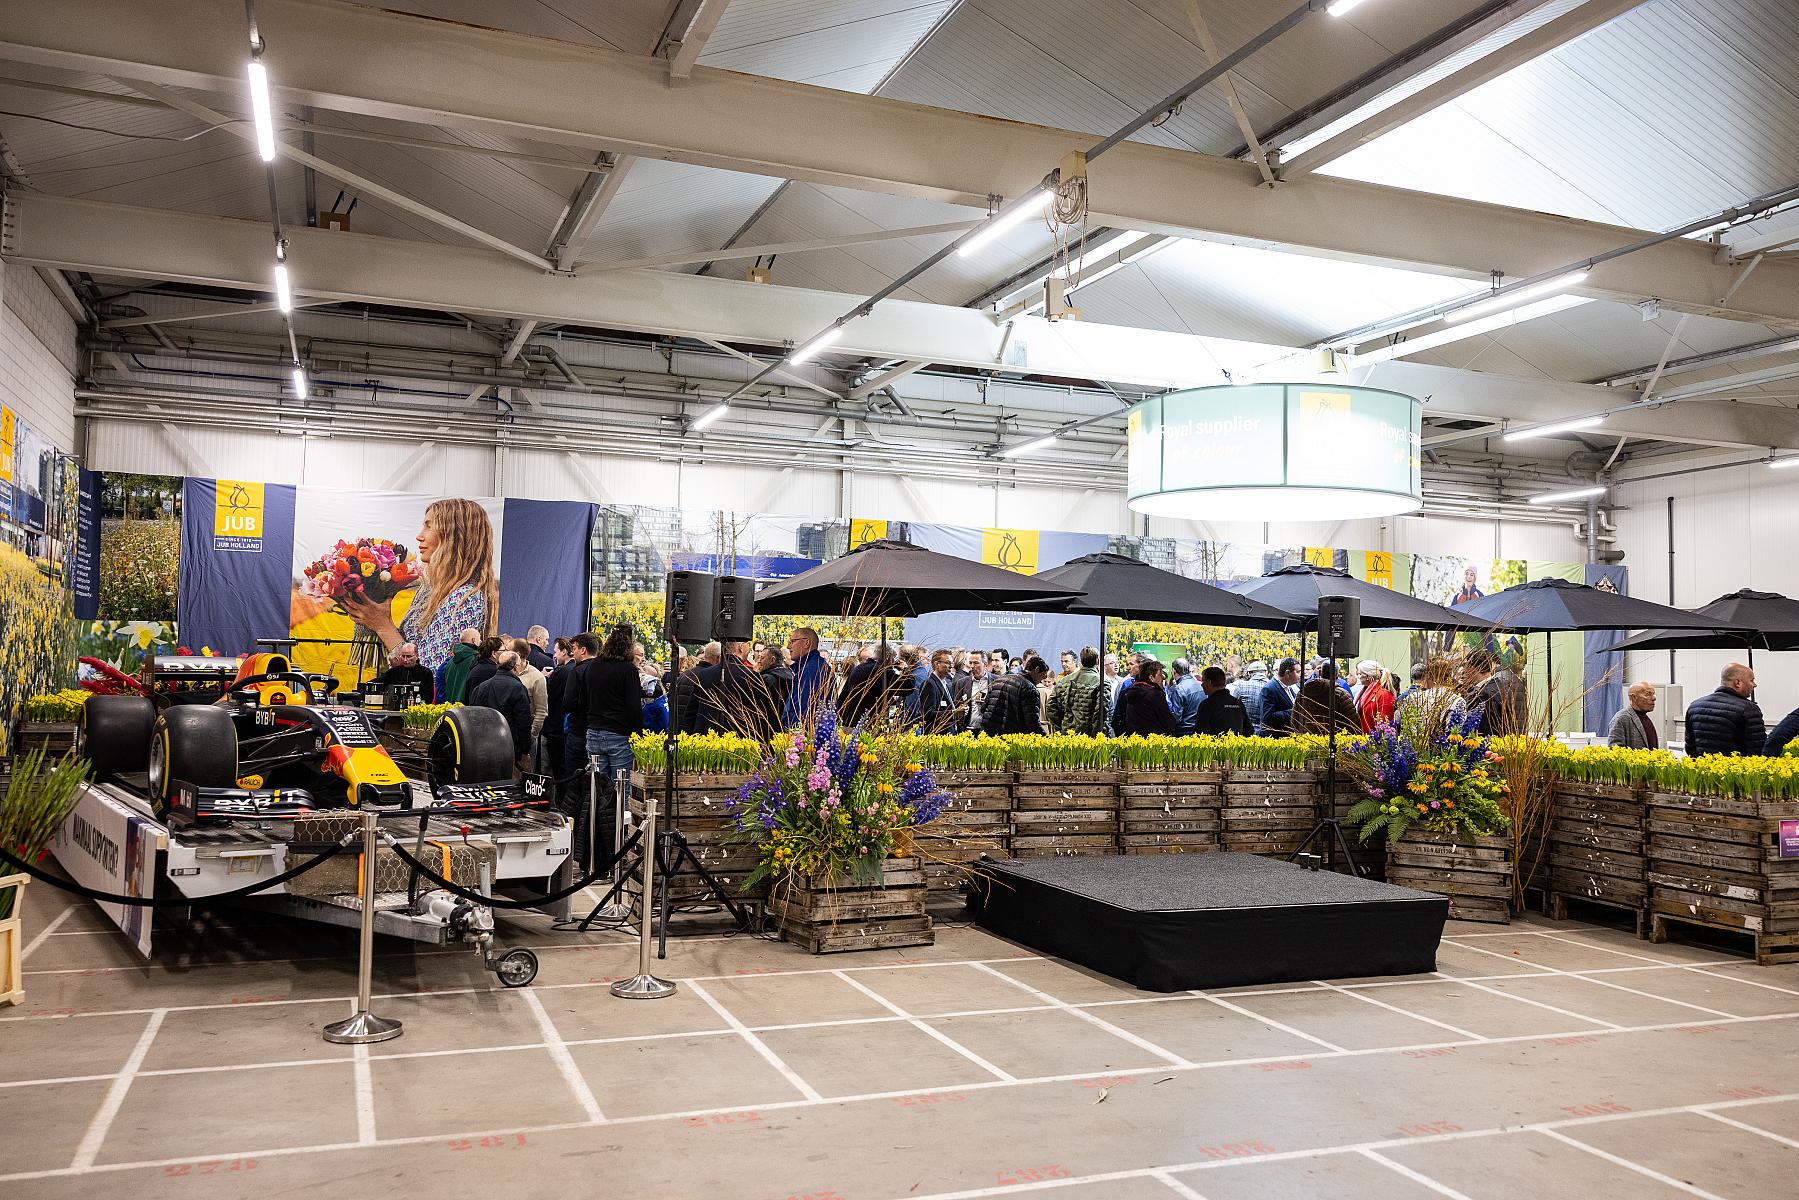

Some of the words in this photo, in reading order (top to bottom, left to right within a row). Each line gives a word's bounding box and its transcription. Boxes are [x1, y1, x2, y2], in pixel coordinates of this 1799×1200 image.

[1160, 419, 1193, 440] Royal
[1195, 415, 1261, 437] supplier
[1380, 421, 1407, 443] Royal
[221, 515, 256, 532] JUB
[982, 616, 997, 624] JUB
[998, 617, 1032, 625] HOLLAND
[243, 778, 261, 787] RAUCH
[525, 778, 544, 797] Claro
